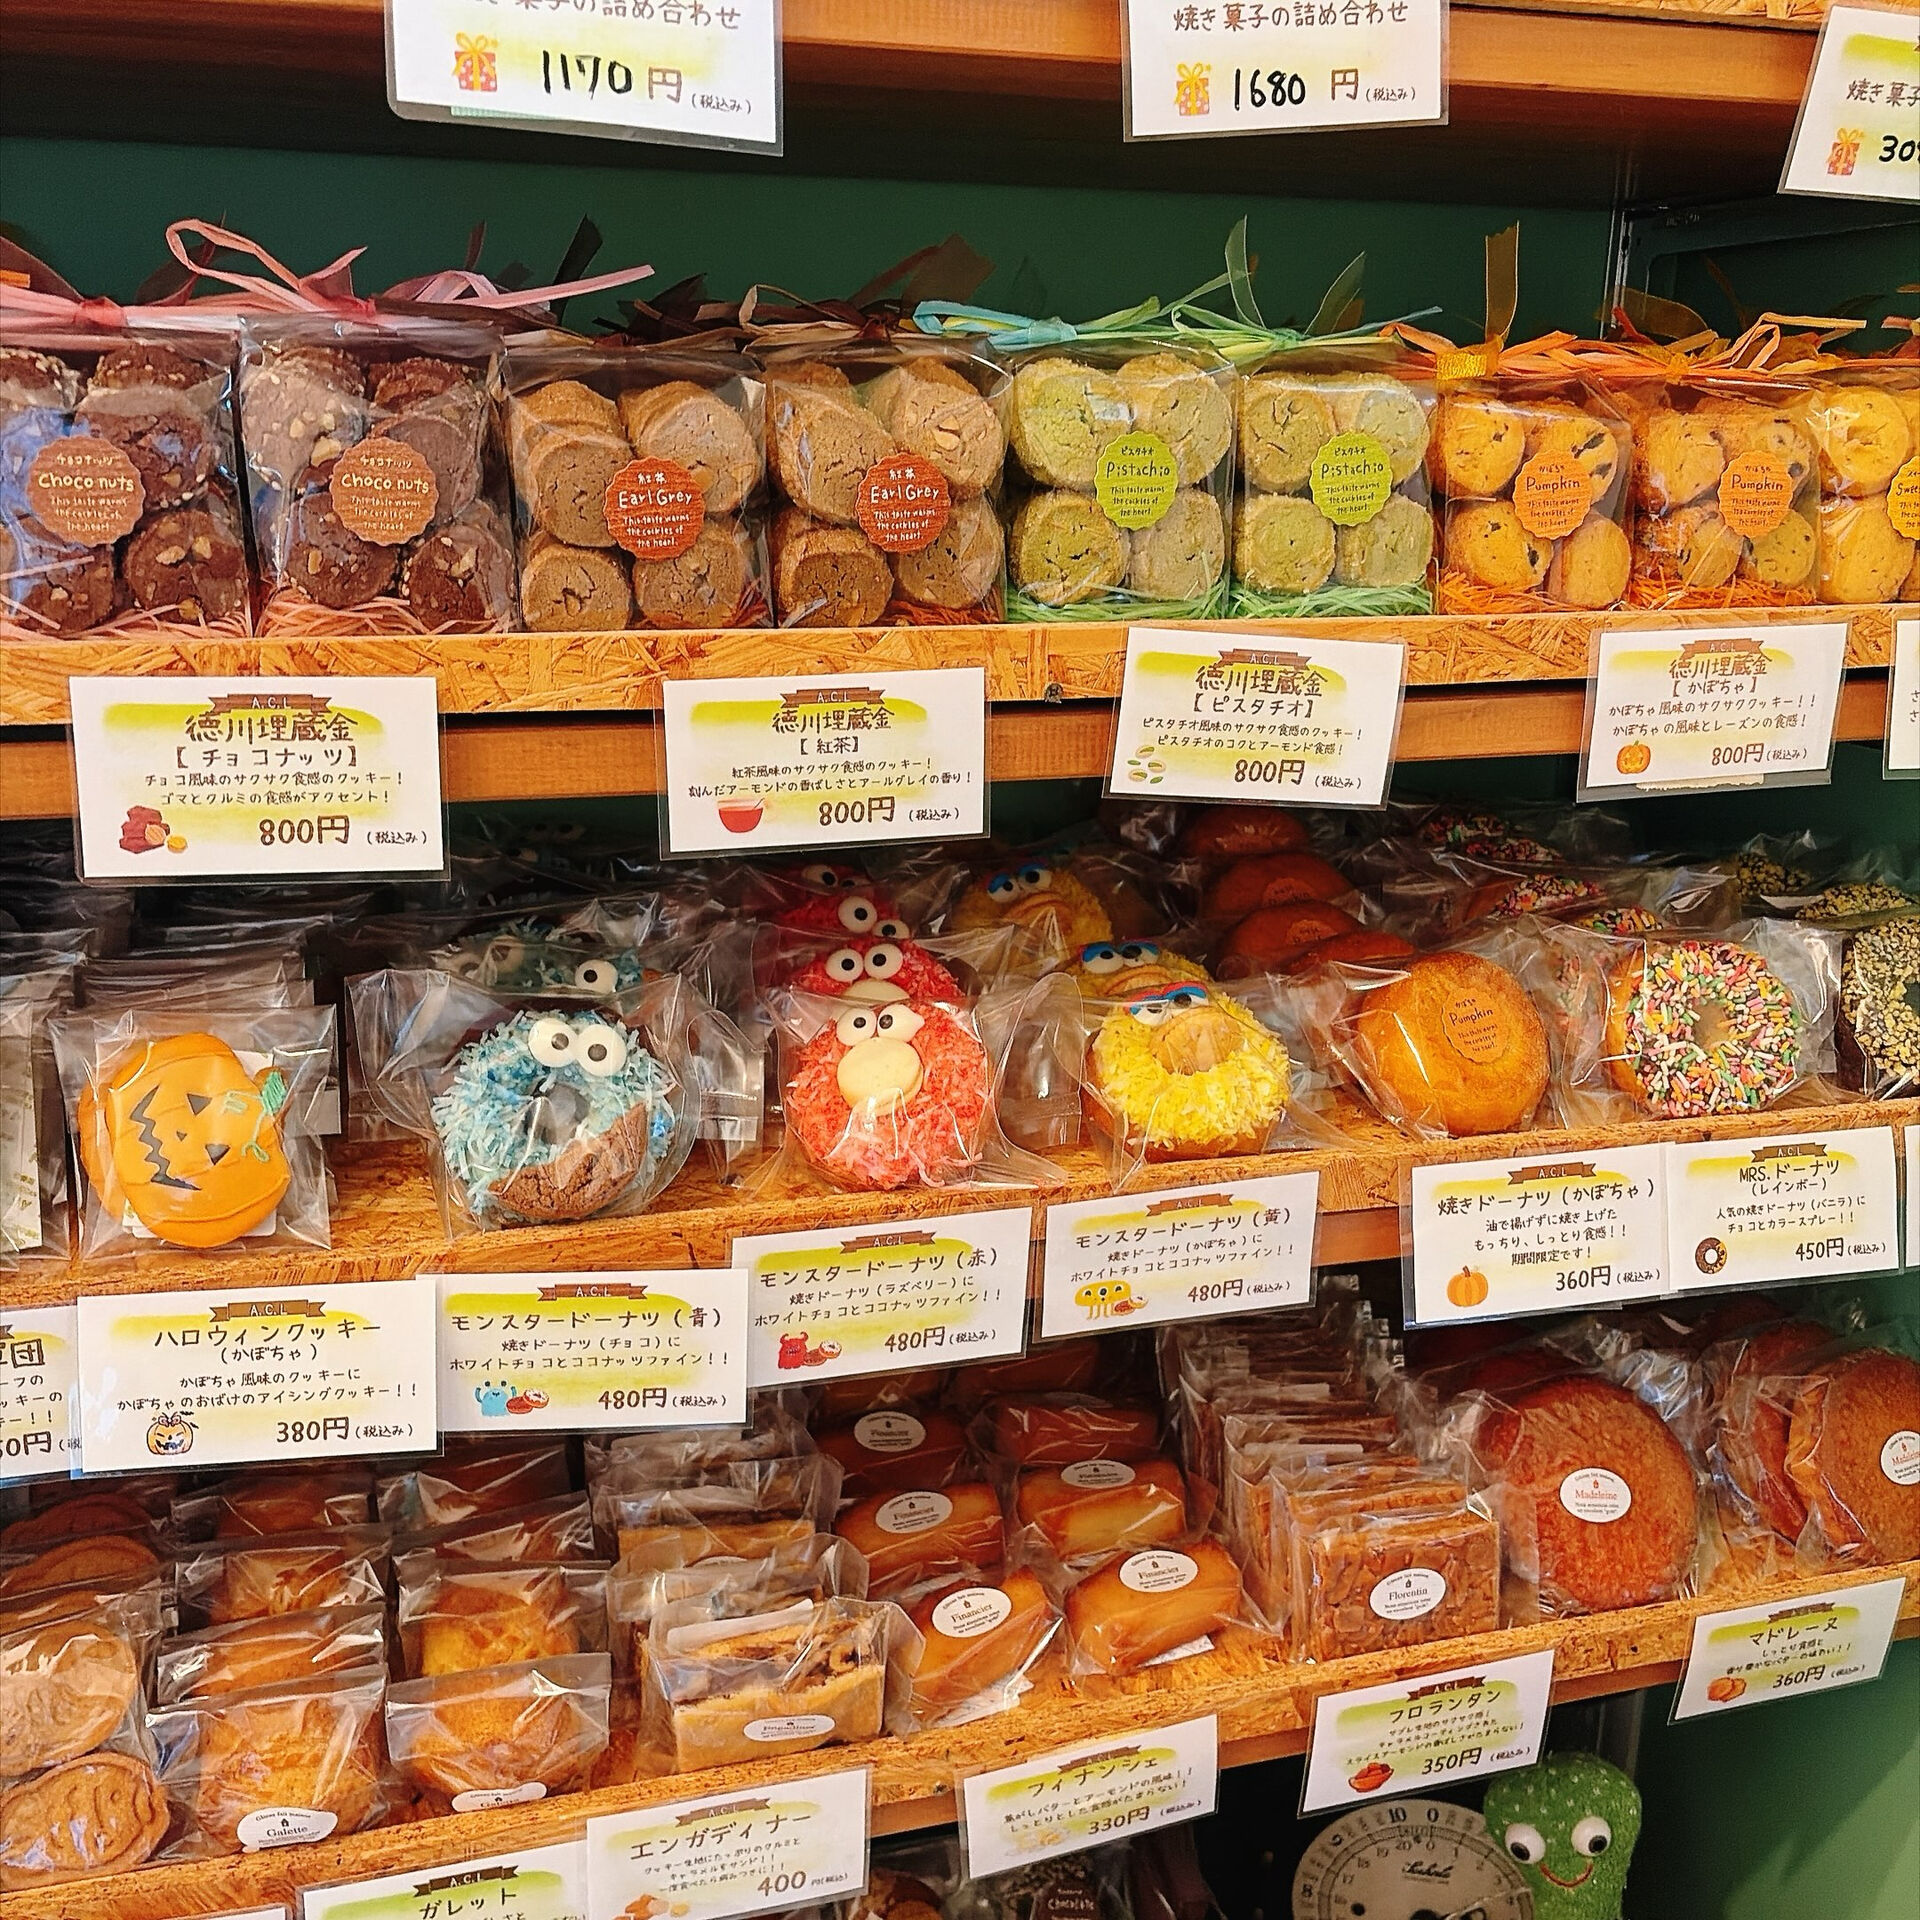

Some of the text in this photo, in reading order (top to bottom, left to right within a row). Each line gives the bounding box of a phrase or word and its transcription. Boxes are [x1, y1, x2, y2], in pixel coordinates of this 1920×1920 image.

[542, 50, 632, 100] 1170
[648, 66, 682, 103] 円
[1234, 68, 1416, 111] 1680 円 （税込み）
[1879, 135, 1920, 163] 30
[38, 472, 134, 492] Choco nuts
[341, 473, 429, 494] Choco nuts
[871, 484, 939, 503] Earl Grey
[1526, 475, 1580, 494] Pumpkin
[1732, 474, 1783, 493] Pumpkin
[1896, 482, 1920, 496] Swee
[619, 489, 692, 508] Earl Grey
[1668, 652, 1773, 679] 徳川埋蔵金
[1196, 664, 1328, 697] 徳川埋蔵金
[185, 711, 358, 744] 徳川埋蔵金
[772, 706, 894, 734] 徳川埋蔵金
[1711, 743, 1808, 767] 800円 （税込み）
[1234, 759, 1362, 790] 800円 （税込み）
[819, 796, 960, 827] 800円 （税込み）
[259, 815, 427, 846] 800円 （税込み）
[1752, 1177, 1827, 1196] （レインボー）
[1795, 1237, 1886, 1261] 450円 （税込み）
[1188, 1278, 1290, 1303] 480円 （税込み）
[1556, 1265, 1660, 1291] 360円 （税込み）
[884, 1326, 996, 1353] 480円 （税込み）
[221, 1344, 318, 1363] （かぼちゃ）
[598, 1387, 727, 1410] 480円 （税込み）
[277, 1416, 413, 1443] 380円 （税込み）
[0, 1431, 52, 1459] 0円
[1389, 1588, 1428, 1601] Florentin
[951, 1604, 992, 1623] Financier
[1750, 1617, 1838, 1646] マドレーヌ
[1773, 1664, 1826, 1689] 360円
[1390, 1690, 1500, 1723] フロランタン
[1422, 1747, 1482, 1775] 350円
[1028, 1758, 1158, 1798] フィナンシェ
[267, 1826, 308, 1837] Galette
[1088, 1805, 1150, 1835] 330円
[630, 1814, 811, 1861] エンガディナー
[757, 1870, 807, 1897] 400
[419, 1887, 517, 1919] ガレット
